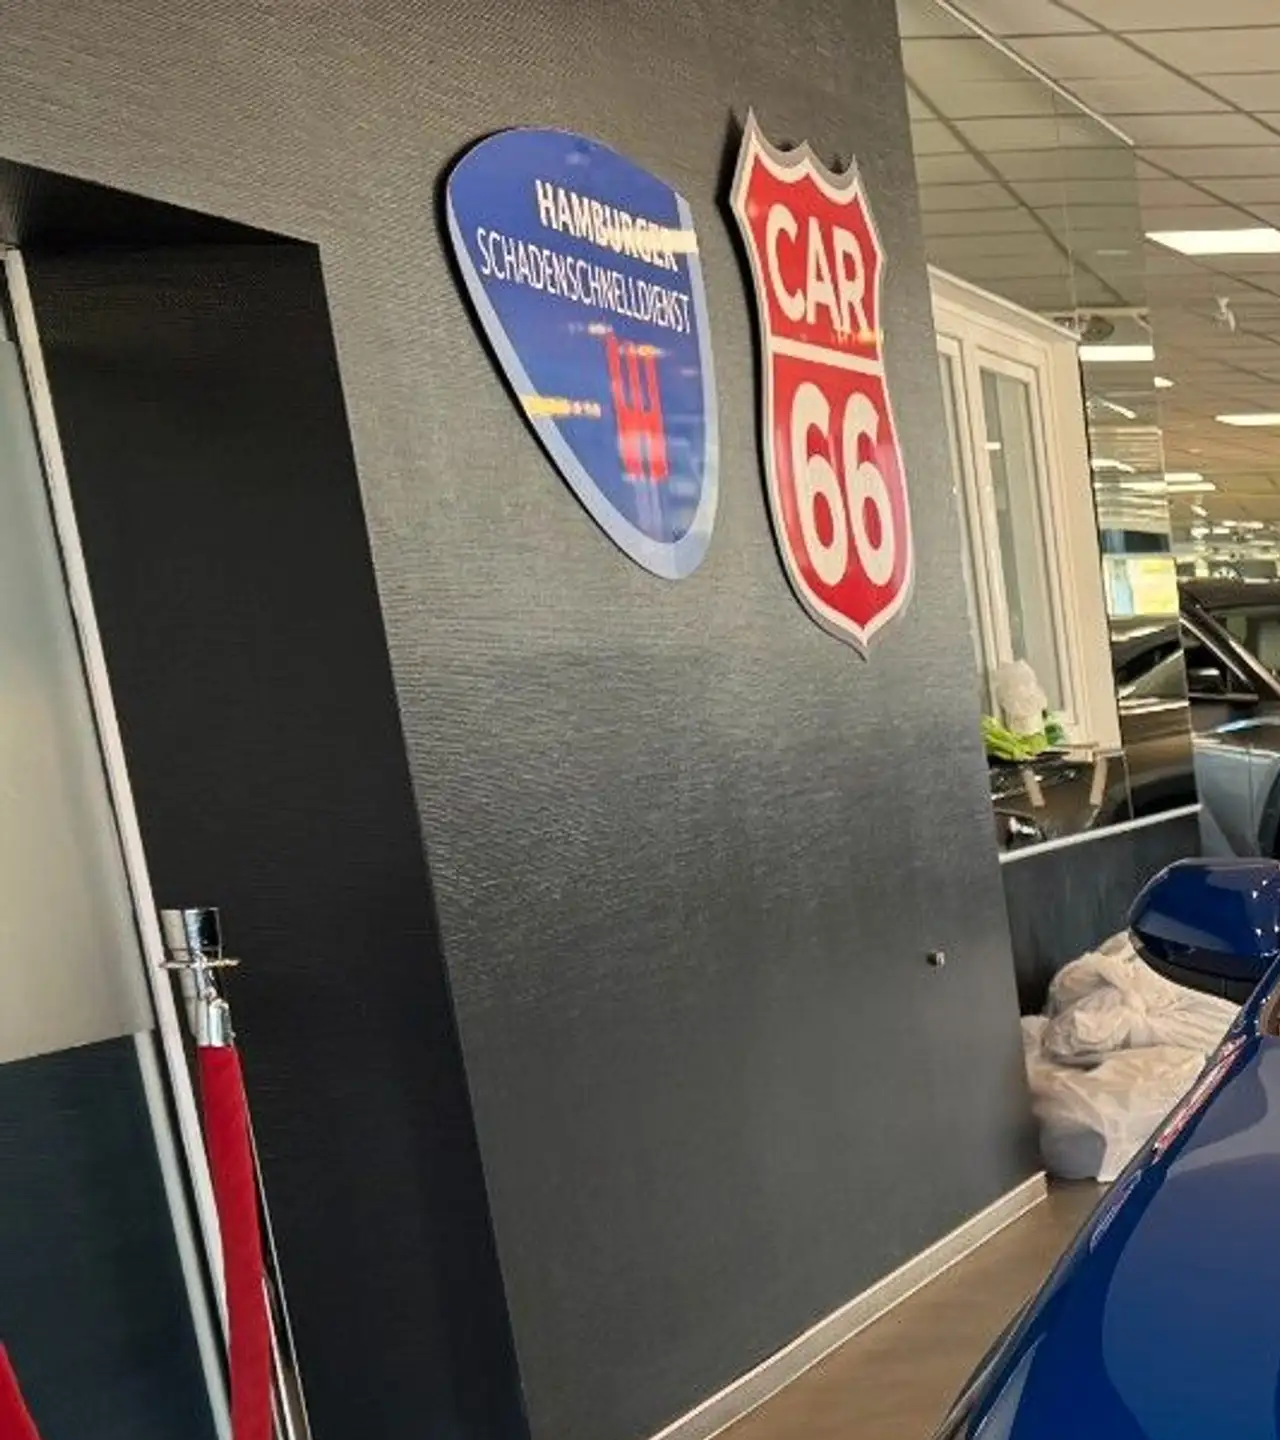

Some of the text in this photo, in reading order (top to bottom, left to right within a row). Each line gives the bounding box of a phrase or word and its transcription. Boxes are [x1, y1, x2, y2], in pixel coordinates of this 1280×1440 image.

[476, 225, 691, 335] SCHADENSCHNELLDIENST
[534, 179, 679, 273] HAMBURGER
[765, 203, 868, 334] CAR
[790, 381, 896, 587] 66
